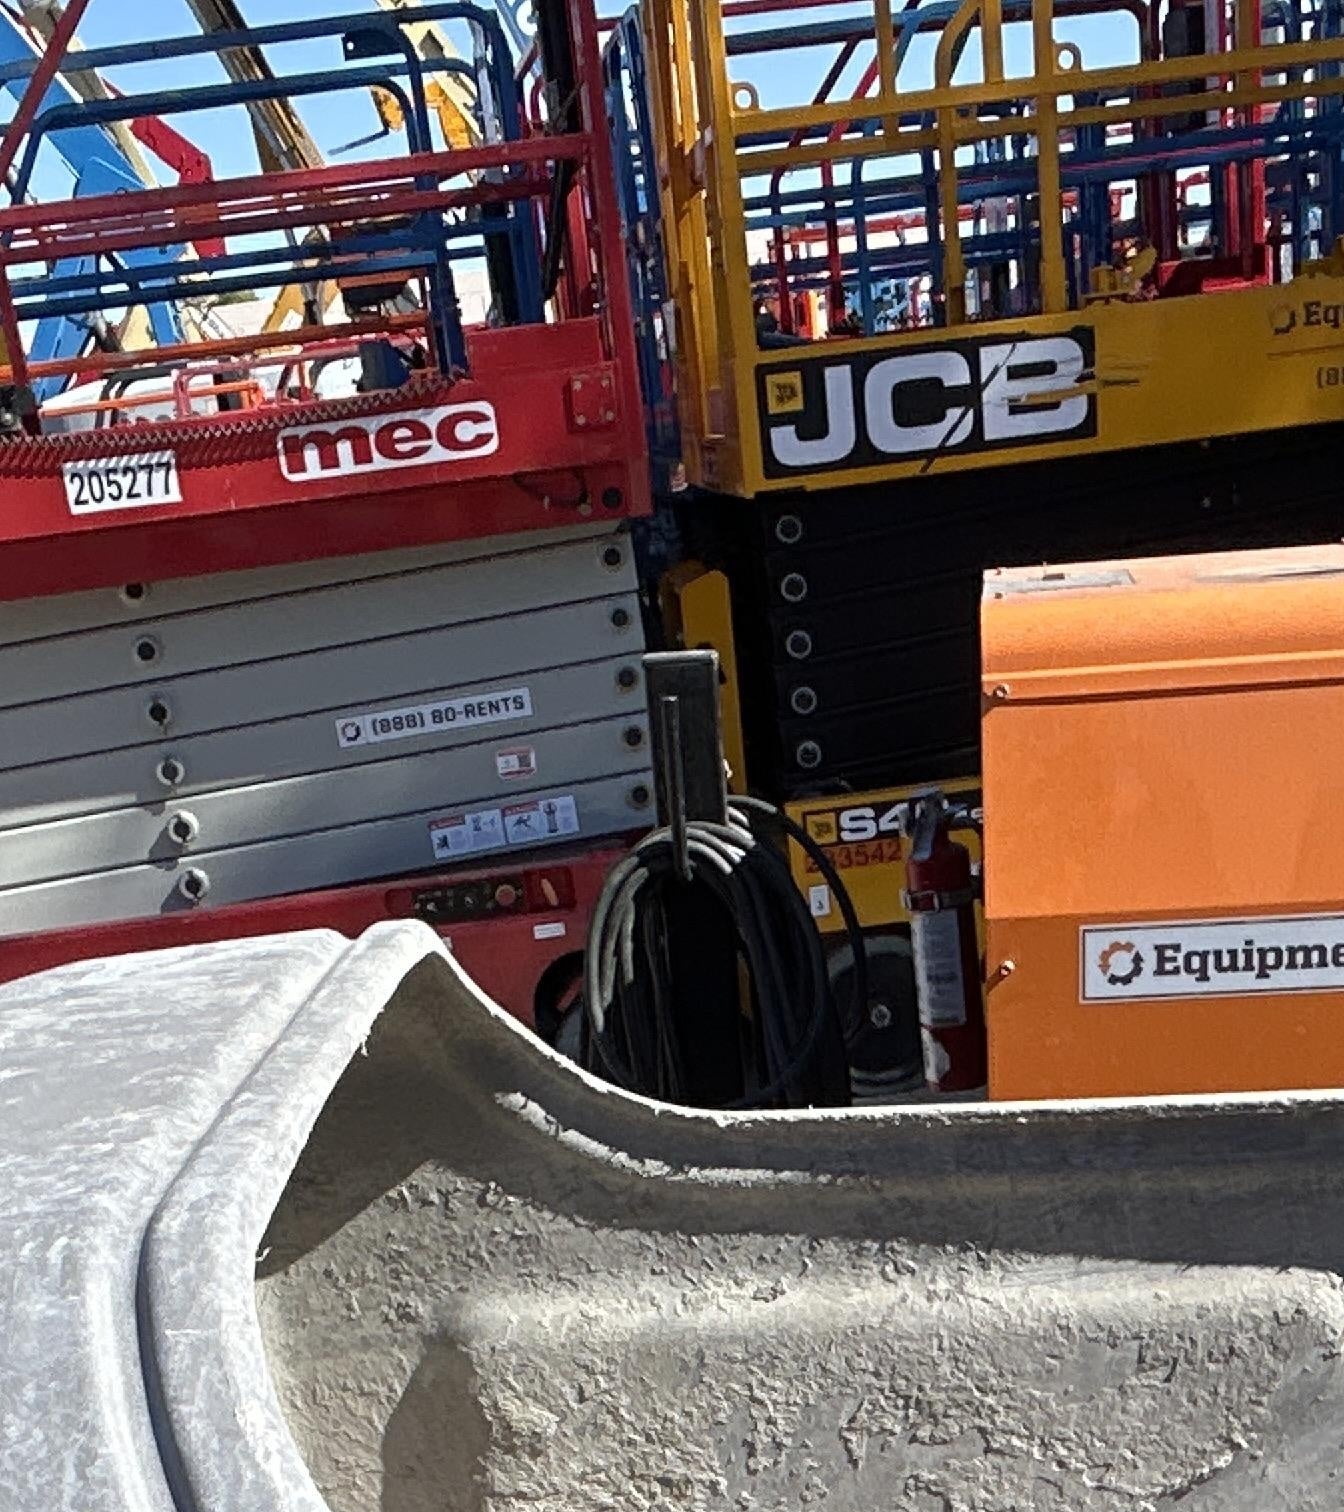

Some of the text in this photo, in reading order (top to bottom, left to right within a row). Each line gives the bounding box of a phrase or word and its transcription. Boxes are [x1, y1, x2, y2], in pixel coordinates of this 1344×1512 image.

[768, 336, 1089, 468] JCB
[280, 410, 495, 475] mec
[68, 462, 174, 507] 205277
[371, 694, 525, 737] (888) 80-RENTS
